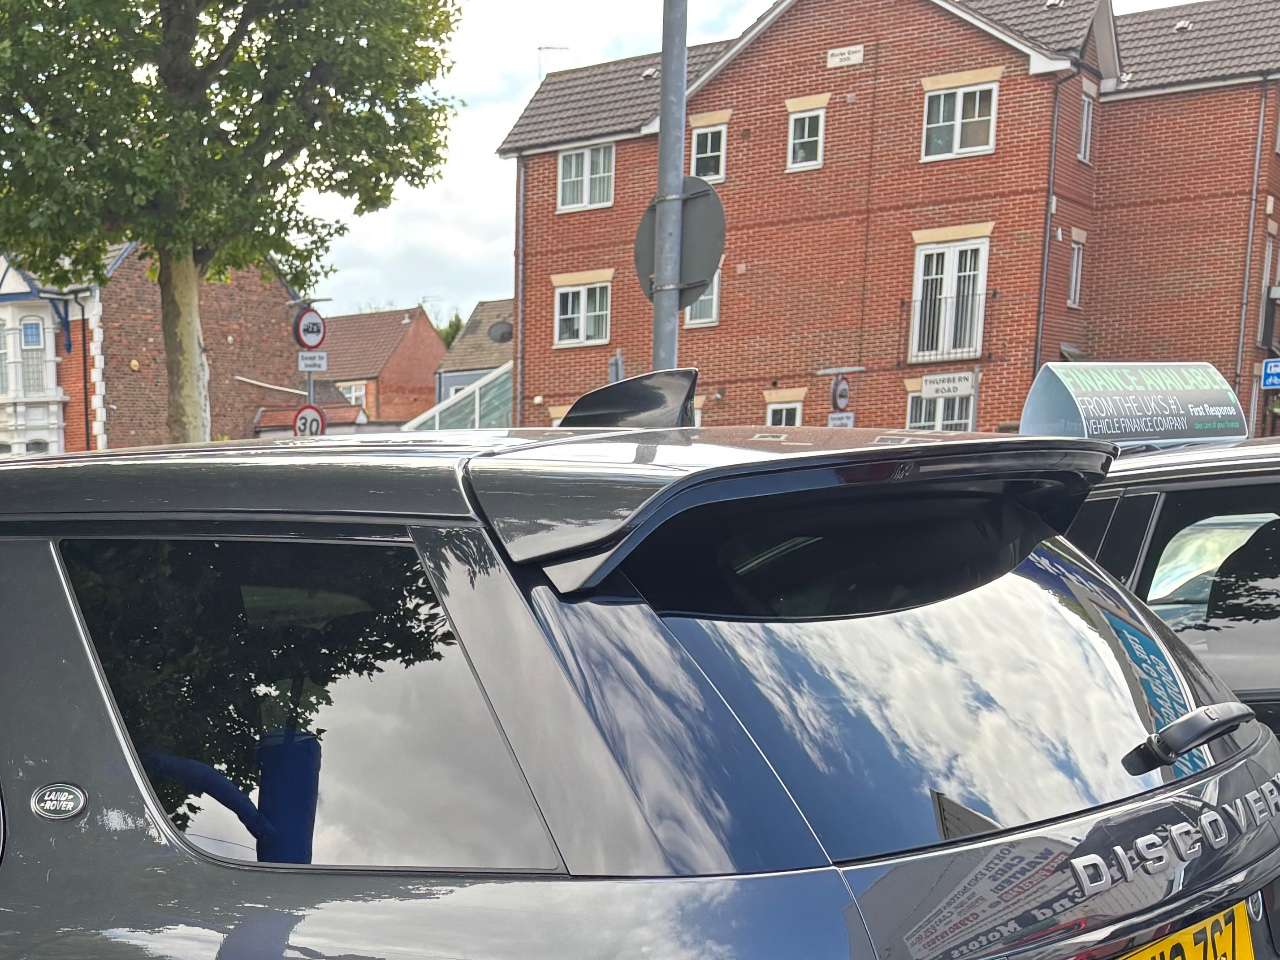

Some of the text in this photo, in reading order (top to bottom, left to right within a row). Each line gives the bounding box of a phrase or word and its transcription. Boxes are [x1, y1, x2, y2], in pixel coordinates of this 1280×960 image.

[924, 375, 970, 386] THURBERN
[1057, 367, 1229, 392] FINANCE AVAILABLE
[934, 386, 959, 395] ROAD
[1078, 395, 1185, 417] FROM THE UK'S #1
[1188, 403, 1237, 418] First Response
[298, 416, 320, 436] 30
[1086, 417, 1120, 435] VEHICLE
[1120, 416, 1154, 434] FINANCE
[1153, 416, 1188, 432] COMPANY
[44, 791, 69, 801] LAND
[43, 800, 75, 811] ROVER
[1070, 772, 1280, 897] DISCOVER
